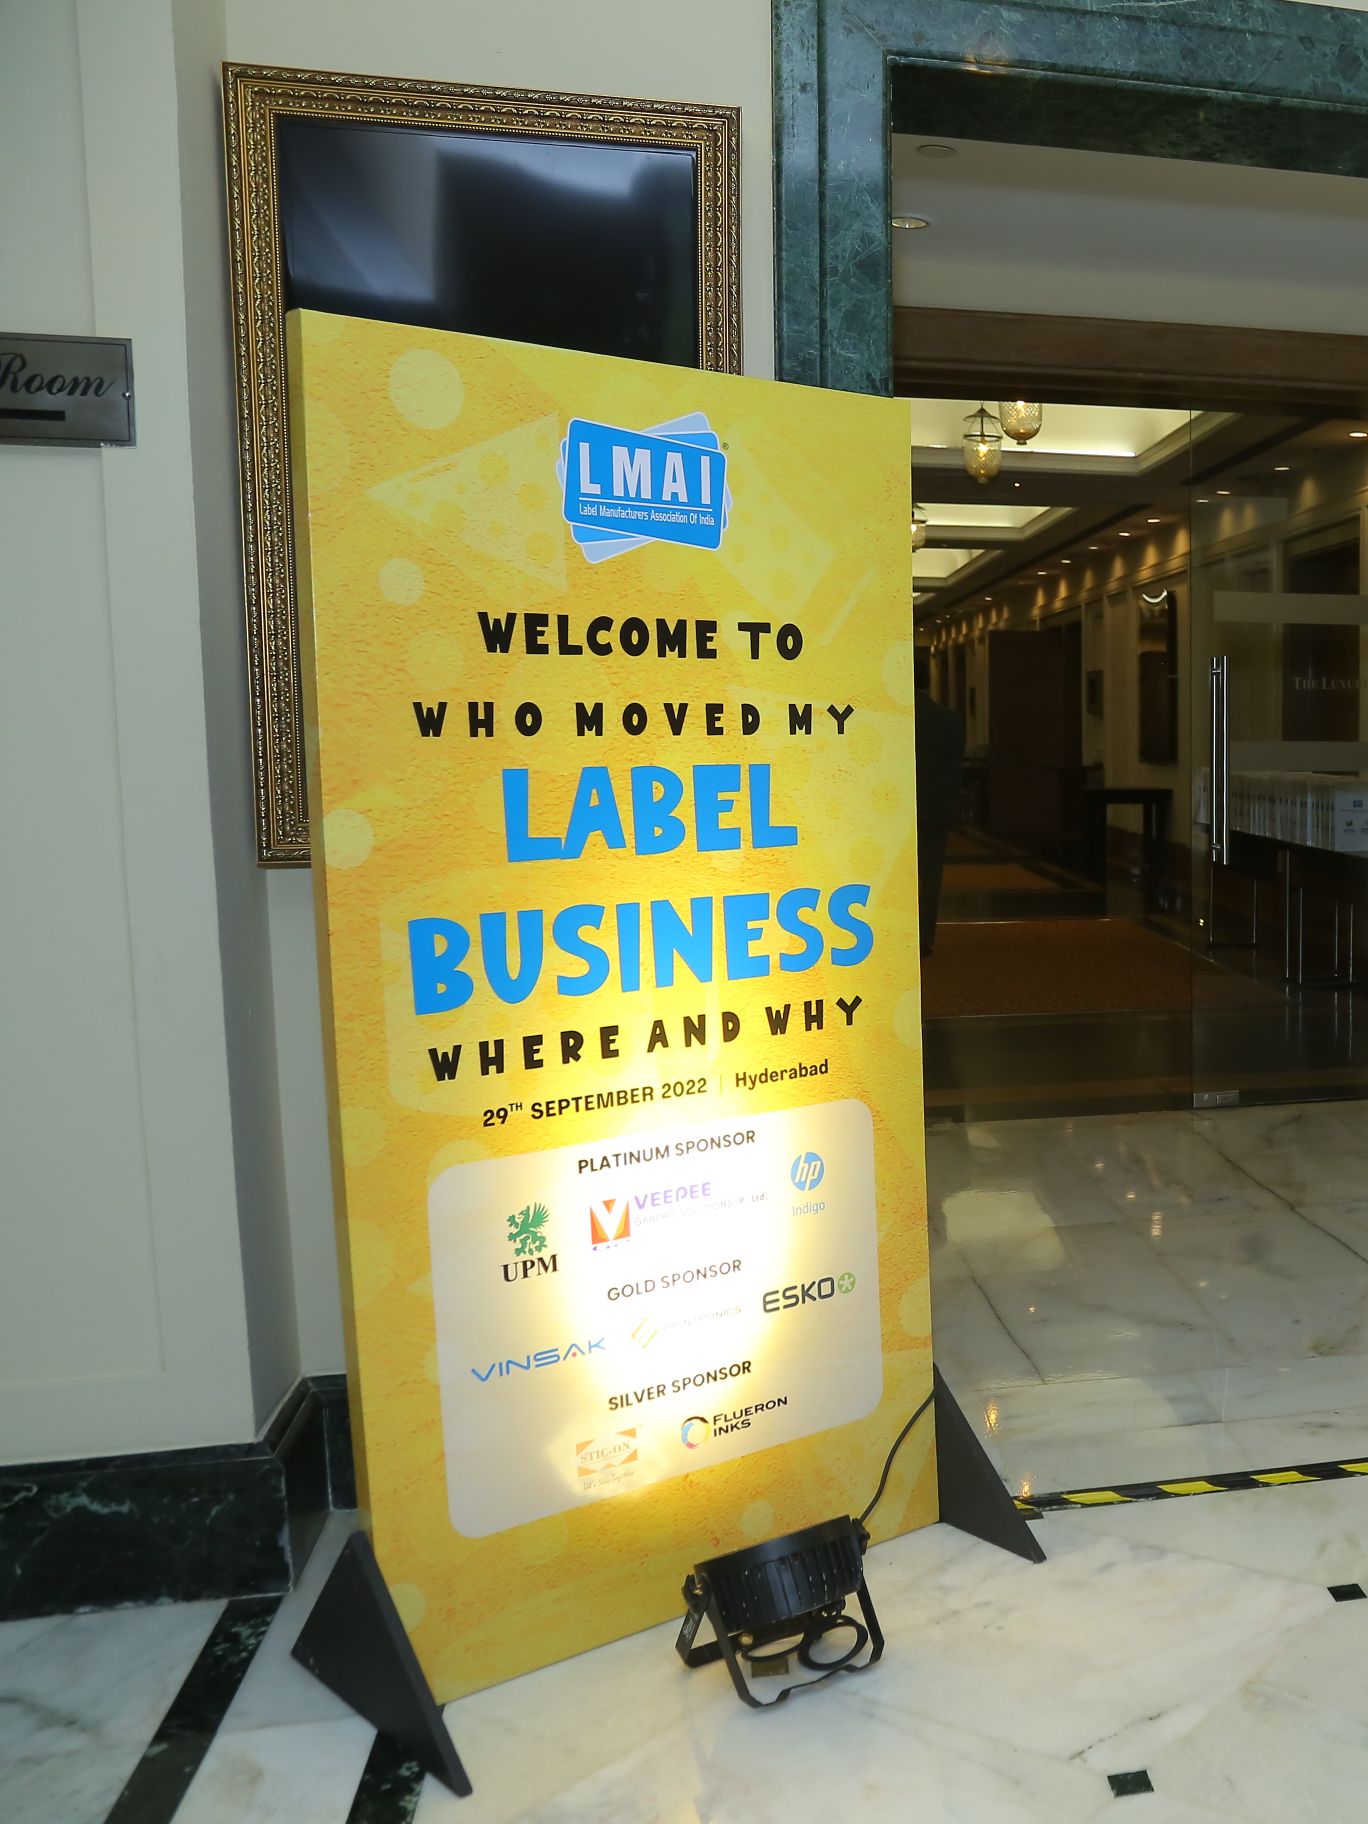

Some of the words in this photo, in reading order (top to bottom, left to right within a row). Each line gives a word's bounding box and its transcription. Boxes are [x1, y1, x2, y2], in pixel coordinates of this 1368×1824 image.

[0, 352, 116, 398] Room
[578, 441, 712, 506] LMAI
[579, 502, 598, 517] Label
[599, 504, 649, 522] Manufacturers
[650, 508, 689, 525] Association
[689, 512, 698, 525] Of
[699, 513, 715, 527] India
[477, 611, 718, 660] WELCOME
[737, 621, 804, 662] TO
[412, 701, 543, 738] WHO
[574, 701, 761, 738] MOVED
[788, 702, 855, 736] MY
[501, 763, 799, 863] LABEL
[407, 883, 875, 1017] BUSINESS
[428, 1024, 620, 1083] WHERE
[646, 1011, 742, 1053] AND
[764, 995, 863, 1037] WHY
[482, 1101, 524, 1128] 29TH
[530, 1086, 656, 1121] SEPTEMBER
[661, 1077, 708, 1101] 2022
[735, 1058, 830, 1091] Hyderabad
[577, 1144, 671, 1175] PLATINUM
[675, 1130, 757, 1157] SPONSOR
[793, 1153, 823, 1192] hp
[634, 1181, 713, 1211] VEEPEE
[791, 1200, 826, 1218] Indigo
[500, 1253, 560, 1283] UPM
[606, 1278, 657, 1302] GOLD
[660, 1258, 743, 1290] SPONSOR
[762, 1276, 836, 1314] ESKO
[470, 1336, 606, 1384] VINSAK
[607, 1384, 667, 1412] SILVER
[670, 1360, 753, 1394] SPONSOR
[712, 1396, 789, 1427] FLUERON
[712, 1418, 752, 1438] INKS
[580, 1439, 631, 1465] STIC-ON
